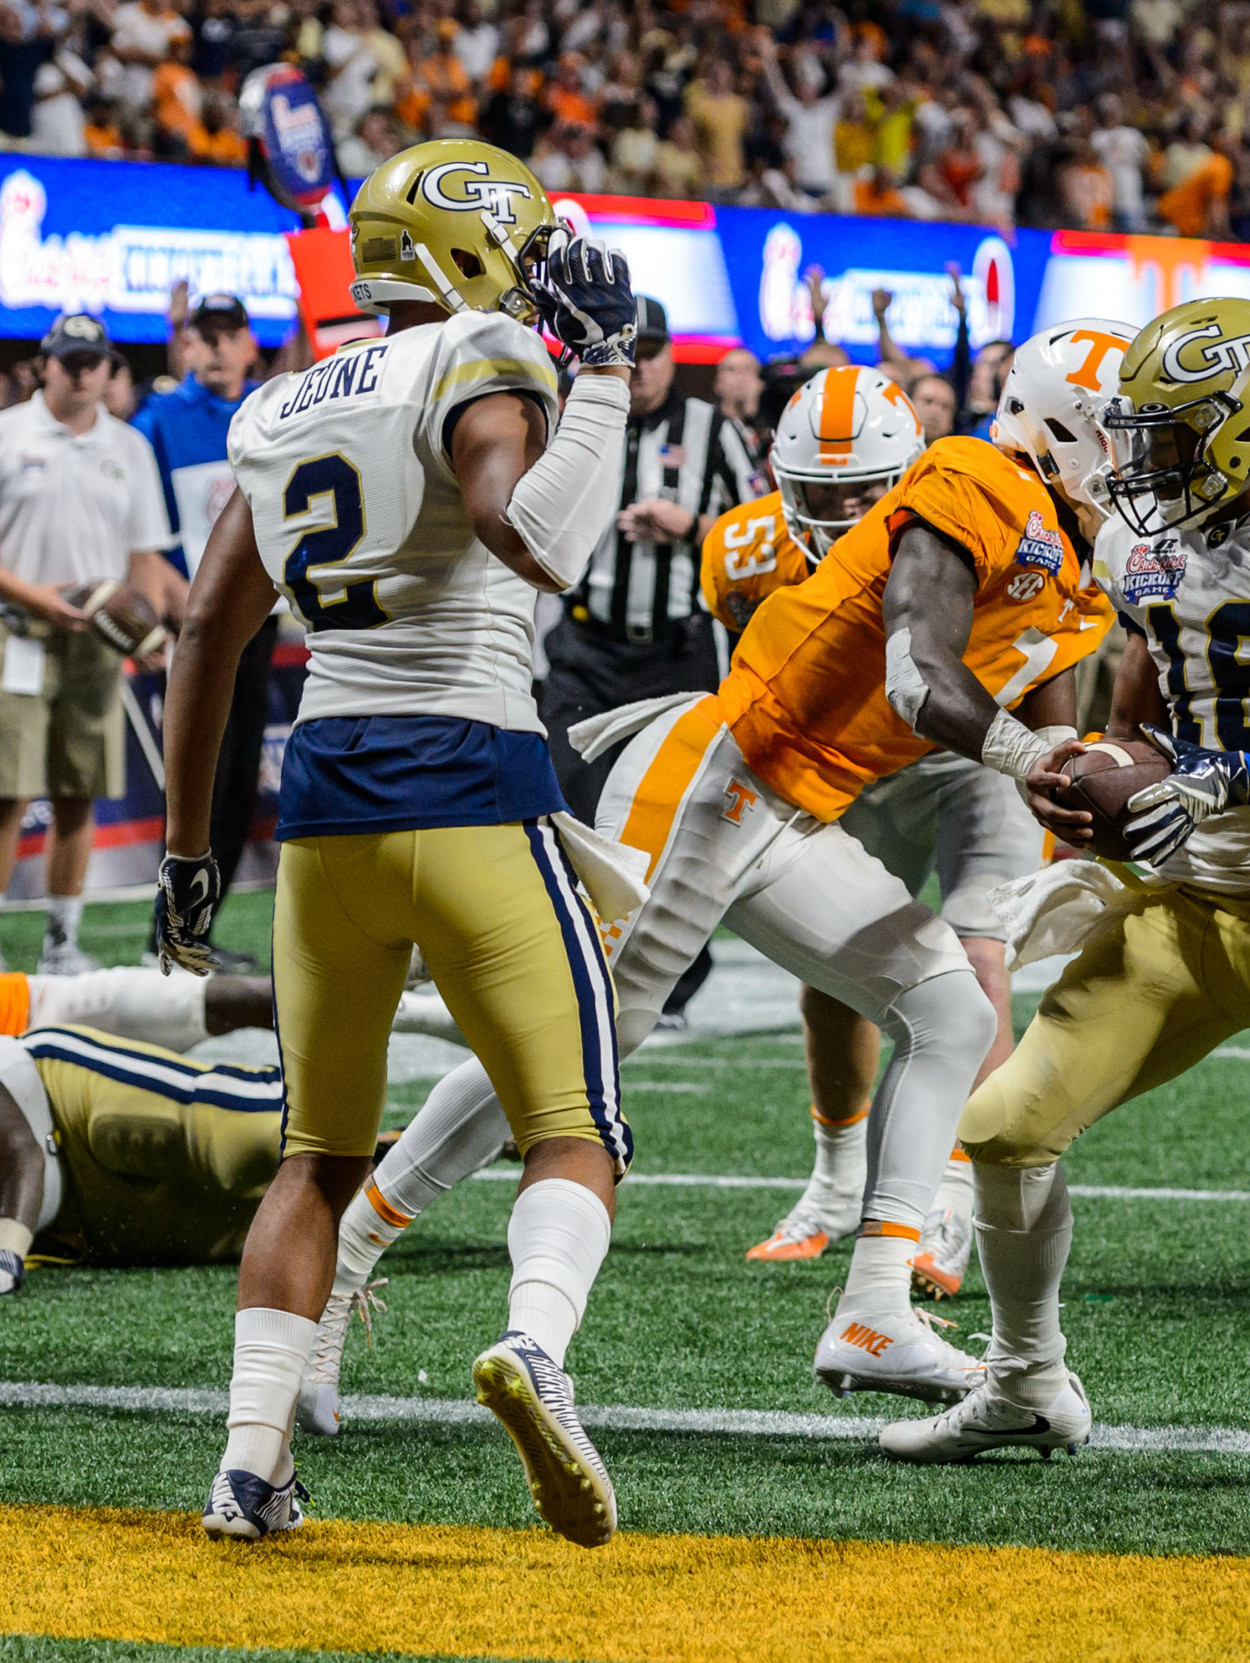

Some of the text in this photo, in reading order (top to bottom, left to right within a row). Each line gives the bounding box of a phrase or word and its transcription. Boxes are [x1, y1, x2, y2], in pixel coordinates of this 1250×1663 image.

[421, 160, 532, 225] GT
[279, 344, 389, 420] JEUNE
[1064, 328, 1132, 393] T
[281, 450, 394, 631] 2
[723, 514, 777, 581] 53
[1006, 572, 1044, 602] SEC
[722, 777, 763, 827] T
[839, 1321, 896, 1358] NIKE
